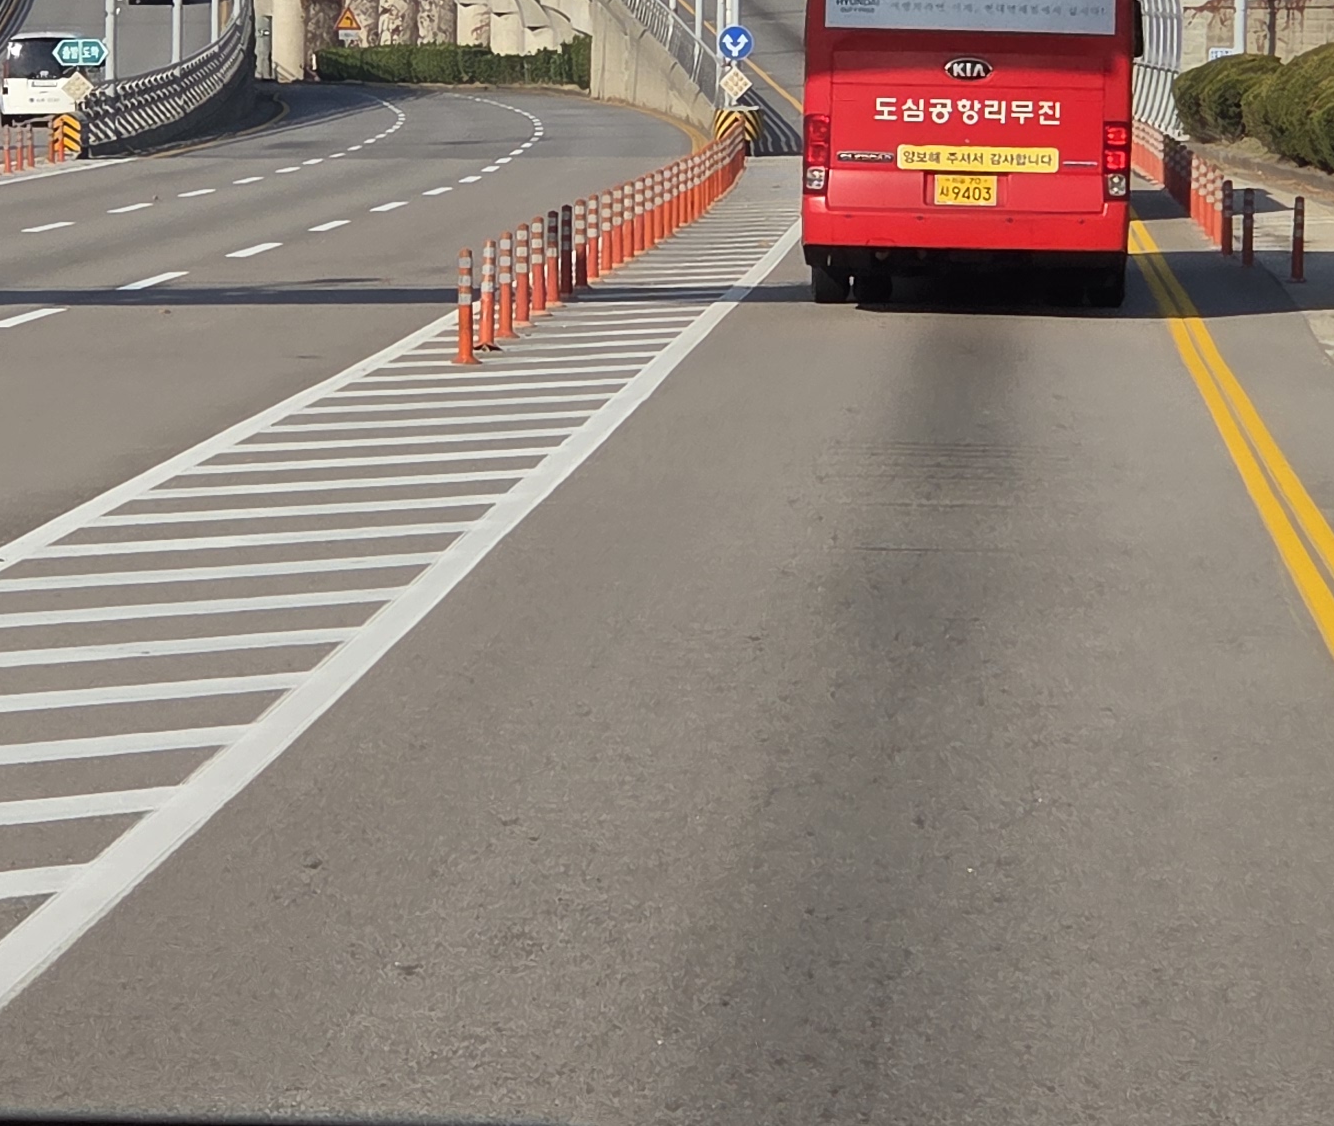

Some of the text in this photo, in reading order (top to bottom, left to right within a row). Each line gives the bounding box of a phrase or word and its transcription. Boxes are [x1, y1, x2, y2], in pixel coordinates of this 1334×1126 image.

[952, 62, 986, 77] KIA
[873, 97, 1061, 125] 도심공항리무진
[990, 153, 1053, 166] 감사합니다
